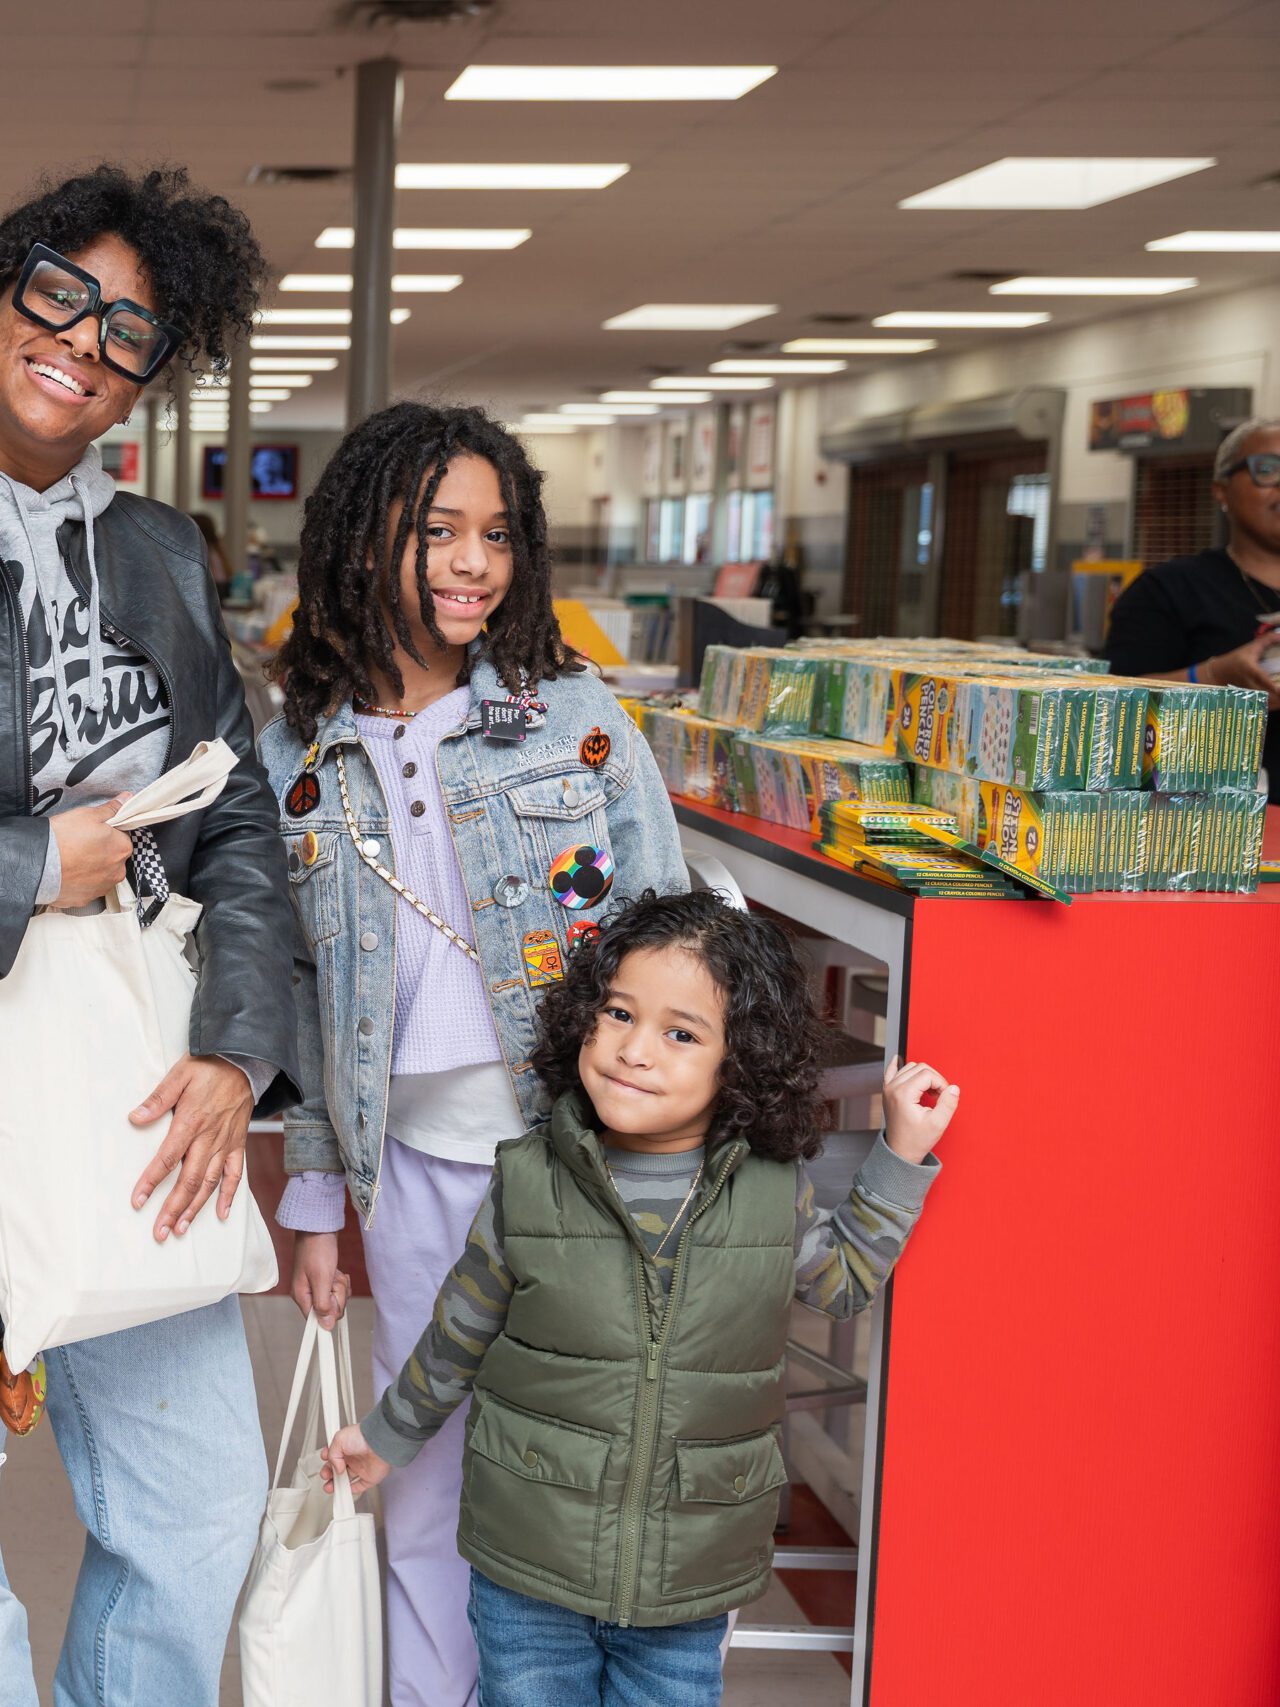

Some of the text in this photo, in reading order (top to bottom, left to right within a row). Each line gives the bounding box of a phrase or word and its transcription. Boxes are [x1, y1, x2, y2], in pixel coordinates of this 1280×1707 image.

[902, 705, 911, 728] 24
[915, 683, 930, 756] PENCILS
[922, 678, 936, 762] COLORED
[1118, 708, 1126, 731] CRAYOLA
[1135, 707, 1143, 730] CRAYOLA
[557, 735, 577, 745] THE
[1061, 732, 1069, 756] COLORED
[1077, 732, 1085, 755] COLORED
[1145, 730, 1154, 748] 12
[1001, 789, 1014, 863] OLORED
[1008, 796, 1022, 863] ENCILS
[1028, 832, 1036, 850] 12
[1004, 865, 1023, 878] CRAYOLA
[1022, 874, 1041, 888] COLORED
[1040, 884, 1057, 896] PENCILS
